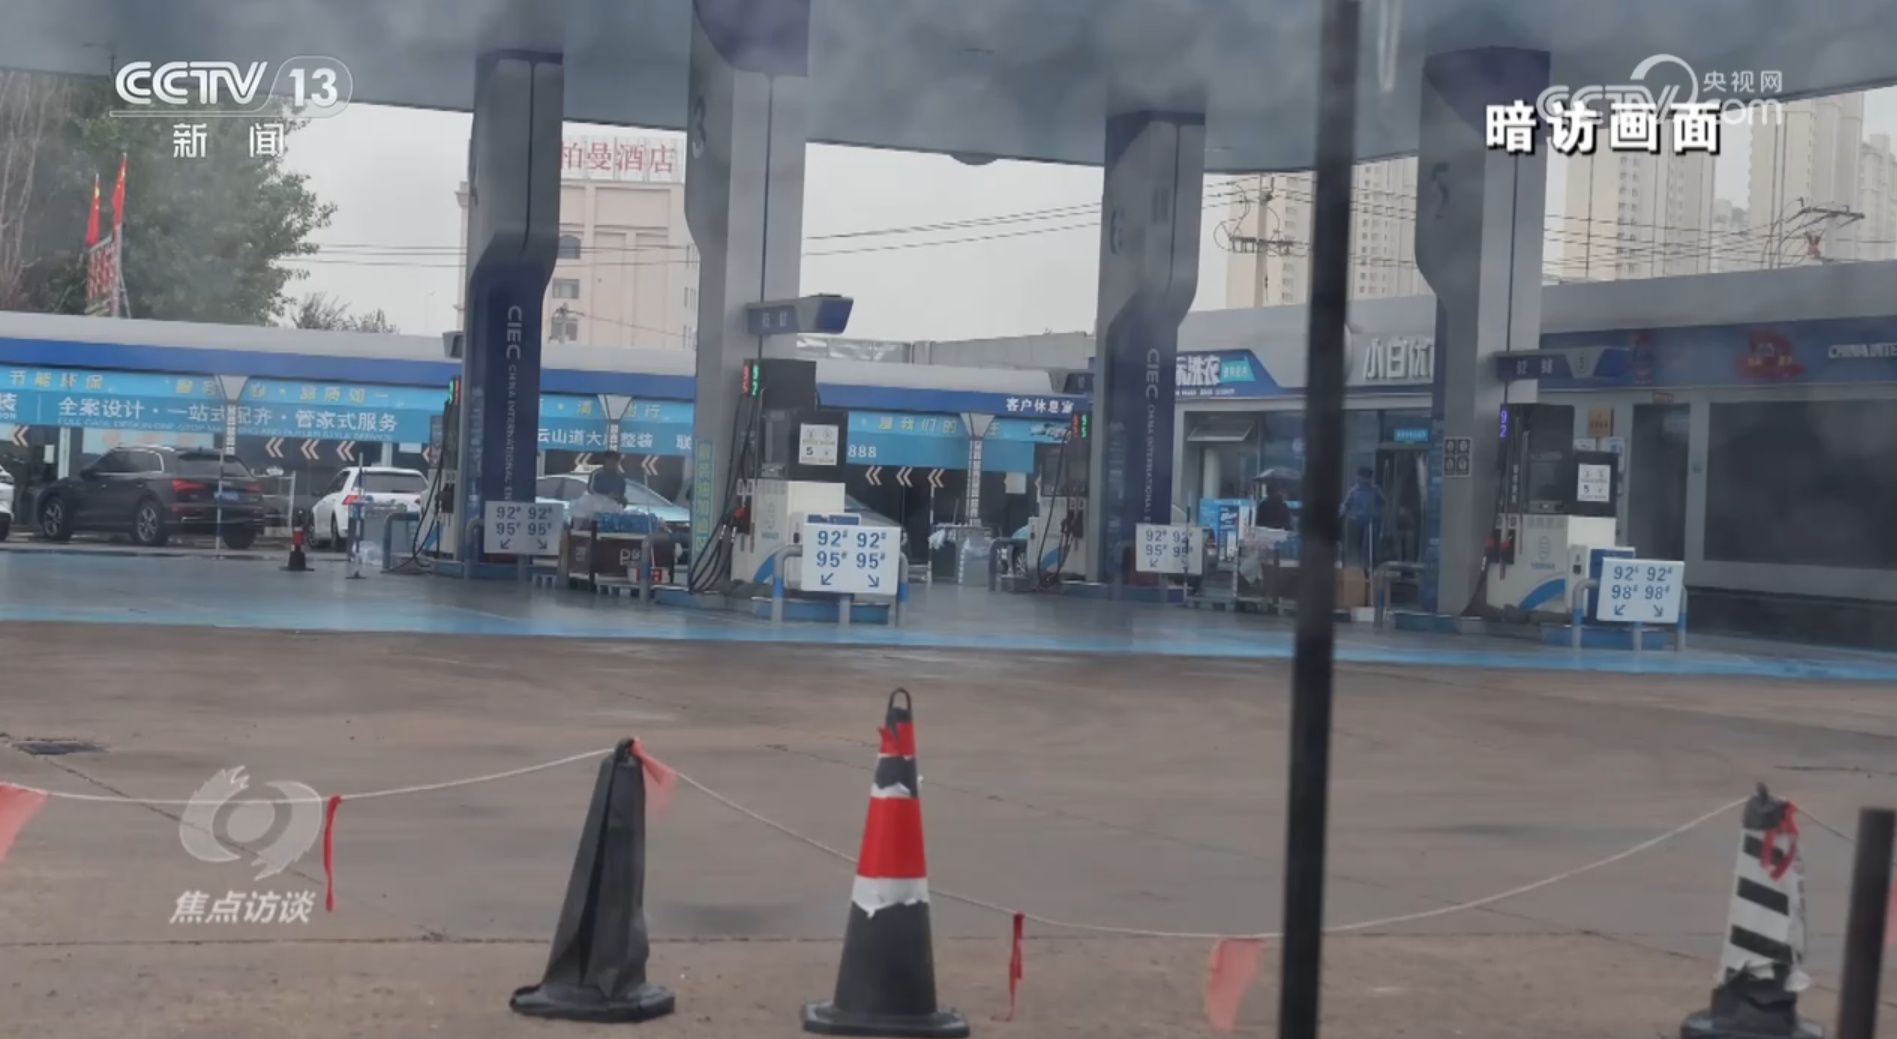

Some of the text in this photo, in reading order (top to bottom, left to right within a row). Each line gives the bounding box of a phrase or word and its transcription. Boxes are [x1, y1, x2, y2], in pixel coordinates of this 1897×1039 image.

[506, 305, 522, 360] CIEC
[507, 364, 517, 398] CHINA
[1145, 348, 1160, 399] CIEC
[848, 445, 877, 459] 888
